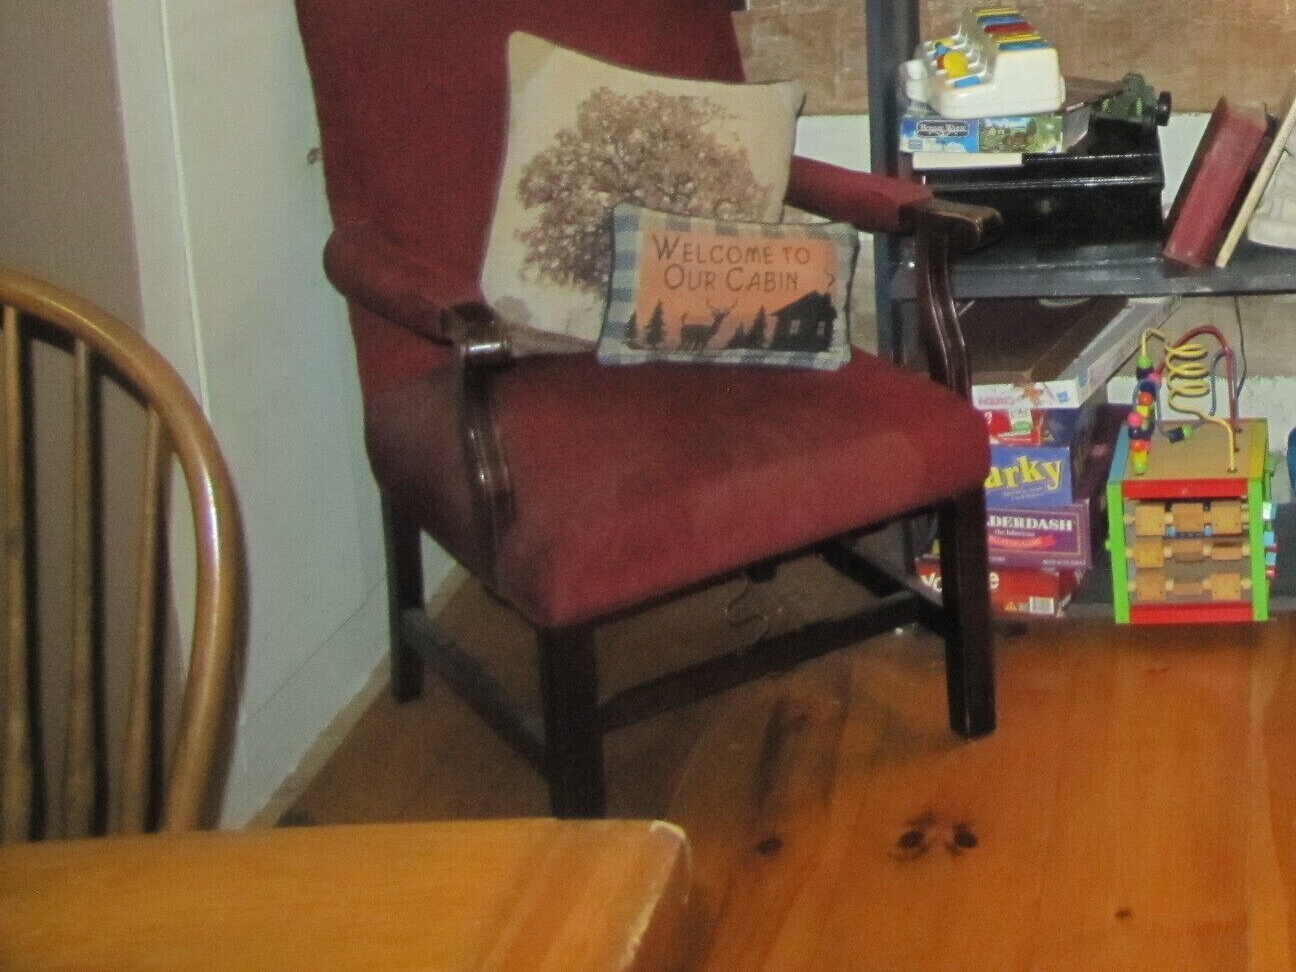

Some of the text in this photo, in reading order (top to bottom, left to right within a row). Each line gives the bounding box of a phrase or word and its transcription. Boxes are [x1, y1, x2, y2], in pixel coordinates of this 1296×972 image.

[652, 234, 811, 265] WELCOME TO
[664, 263, 799, 292] OUR CABIN
[984, 455, 1062, 491] arky
[987, 515, 1073, 531] DERDASH
